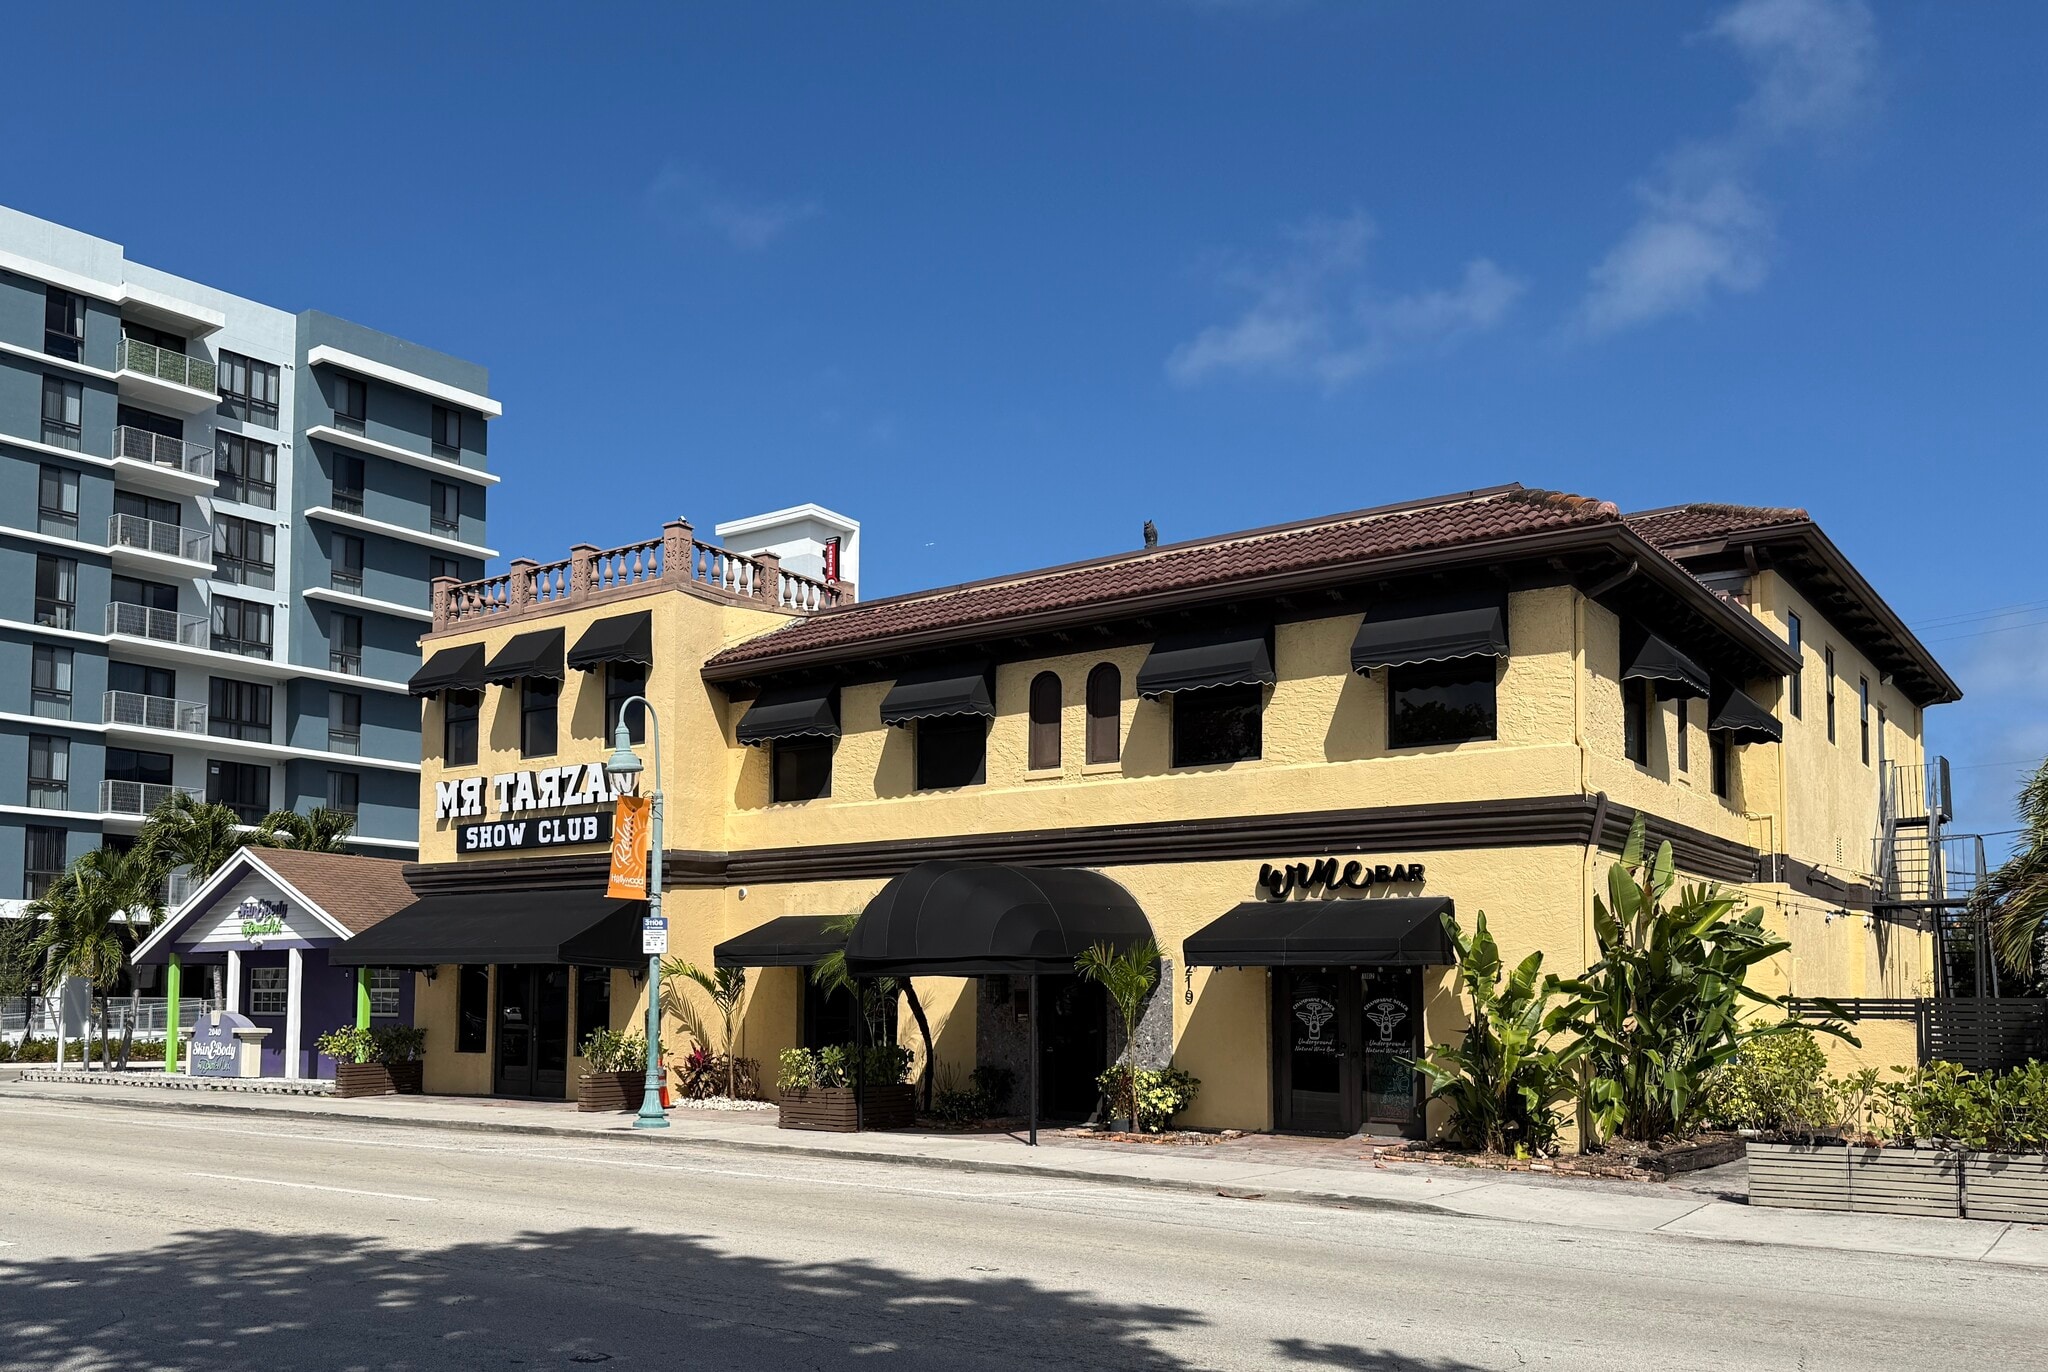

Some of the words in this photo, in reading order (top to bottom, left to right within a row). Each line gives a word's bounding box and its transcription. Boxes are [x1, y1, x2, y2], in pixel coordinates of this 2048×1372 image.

[466, 822, 526, 849] SHOW
[538, 816, 598, 844] CLUB
[613, 811, 635, 868] Relax
[611, 873, 644, 886] Hollywood
[1375, 863, 1426, 883] BAR
[208, 1027, 222, 1037] 2040
[1298, 1038, 1333, 1046] Underground
